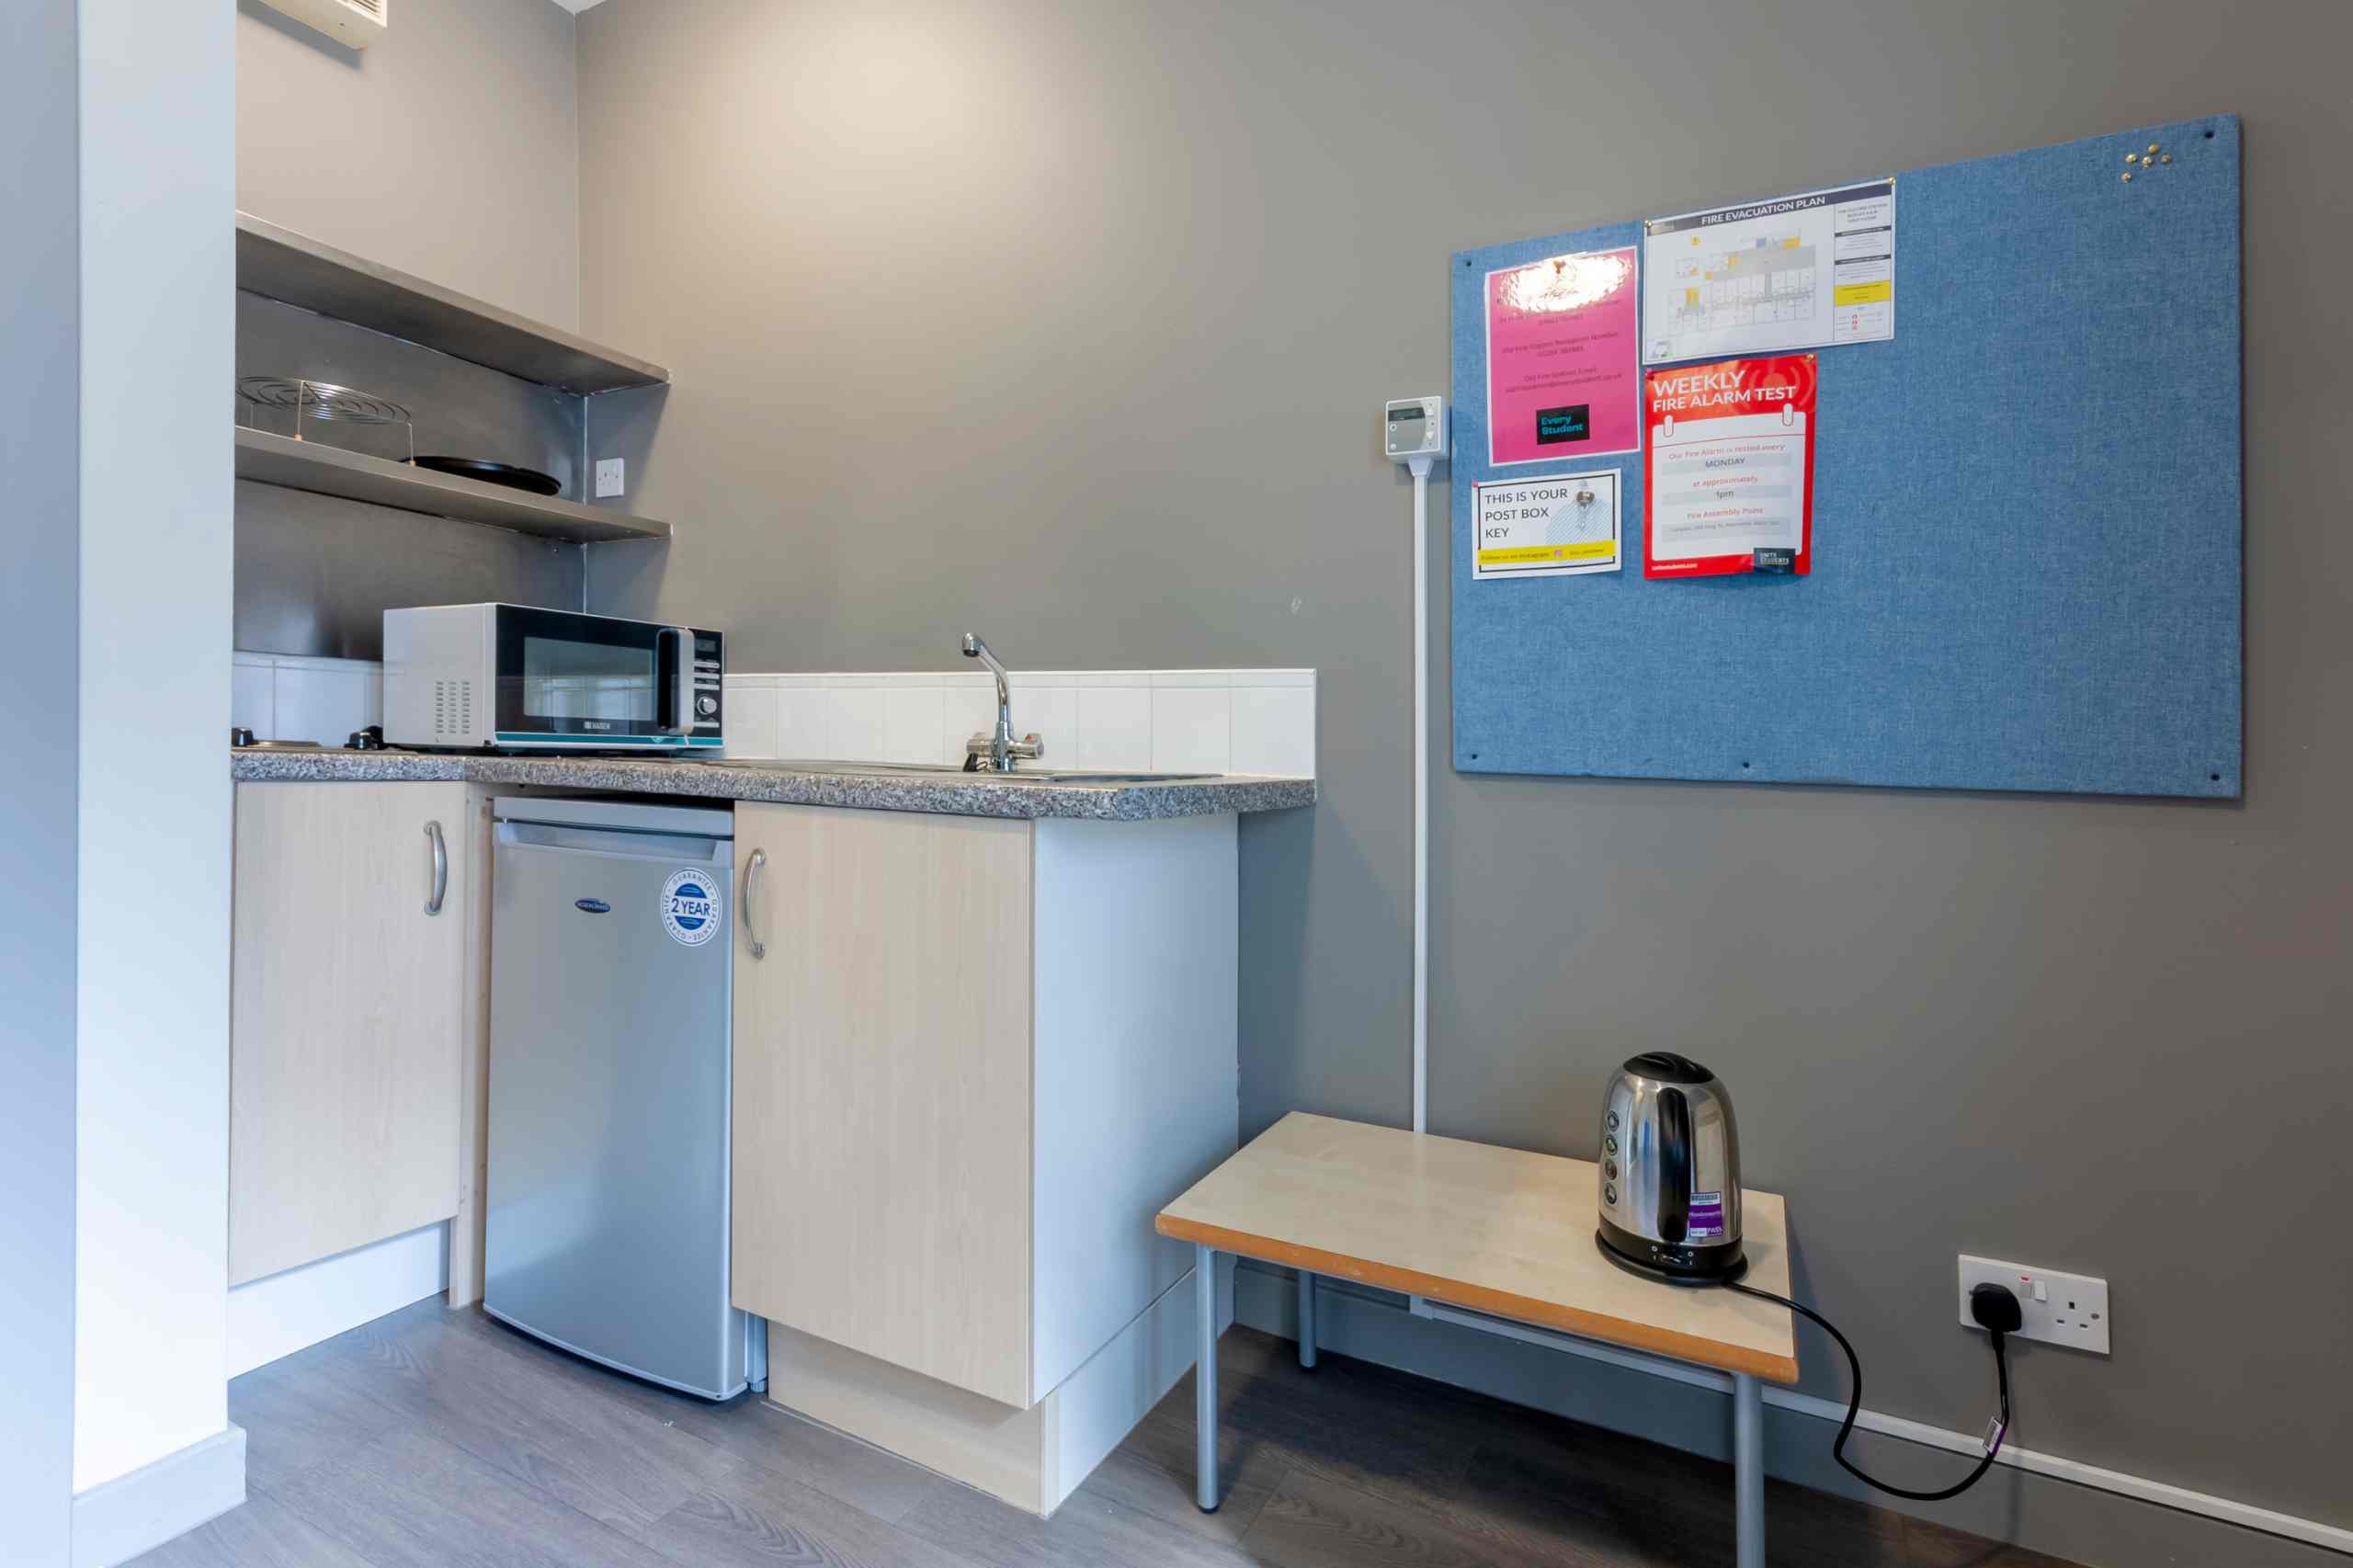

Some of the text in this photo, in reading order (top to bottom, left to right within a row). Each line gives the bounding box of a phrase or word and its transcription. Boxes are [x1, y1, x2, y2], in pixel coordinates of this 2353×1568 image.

[1701, 215, 1724, 226] FIRE
[1726, 202, 1794, 222] EVACUATION
[1796, 196, 1825, 209] PLAN
[1653, 370, 1745, 397] WEEKLY
[1653, 386, 1797, 413] FIRE ALARM TEST
[1540, 415, 1572, 426] Every
[1541, 422, 1584, 435] Student
[1684, 449, 1699, 459] Fire
[1700, 447, 1723, 456] Alarm
[1705, 458, 1745, 468] MONDAY
[1702, 474, 1758, 487] approximately
[1485, 488, 1568, 505] THIS IS YOUR
[1485, 507, 1550, 522] POST BOX
[1485, 528, 1509, 539] KEY
[671, 897, 710, 916] 2 YEAR
